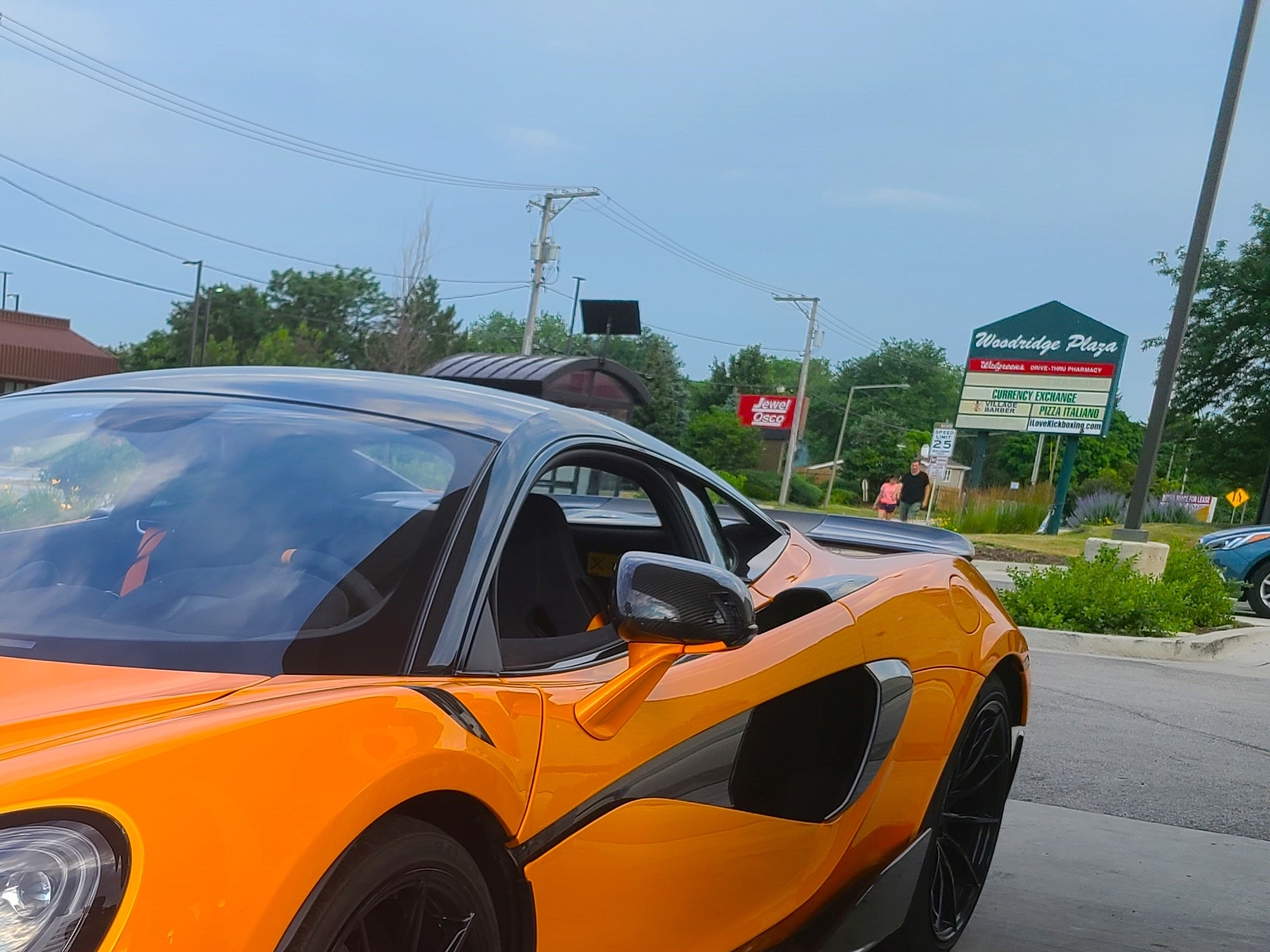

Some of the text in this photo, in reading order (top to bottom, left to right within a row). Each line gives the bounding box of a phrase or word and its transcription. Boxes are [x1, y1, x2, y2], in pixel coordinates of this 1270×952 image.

[975, 331, 1118, 358] Woodridge Plaza
[1030, 365, 1066, 373] DRIVE-THRU
[992, 389, 1078, 403] CURRENCY EXCHANGE
[752, 397, 792, 412] Jewel
[985, 401, 1017, 409] VILLAGE
[753, 412, 784, 423] Osco
[1039, 406, 1099, 419] PIZZA ITALIANO
[933, 440, 951, 449] 25
